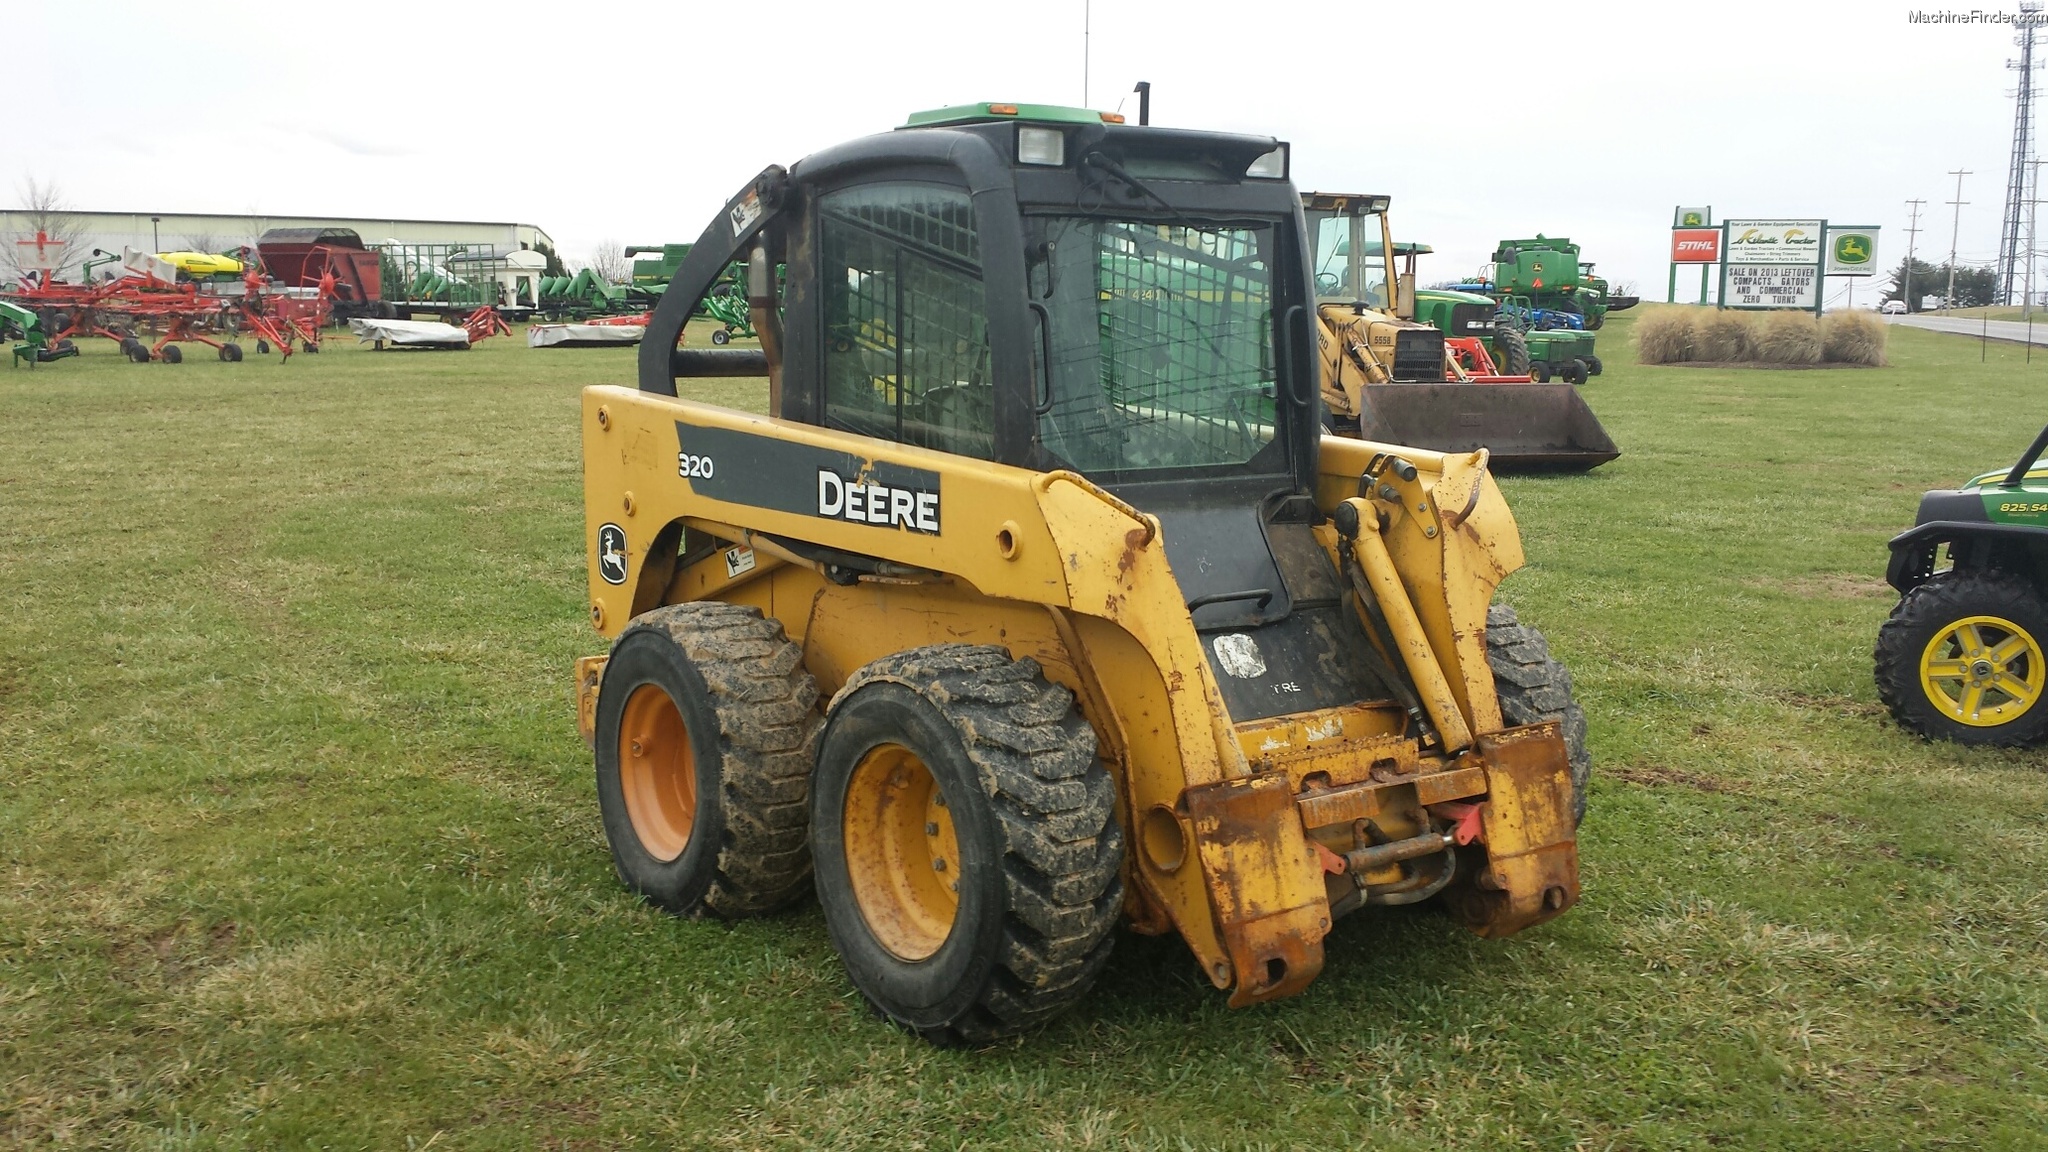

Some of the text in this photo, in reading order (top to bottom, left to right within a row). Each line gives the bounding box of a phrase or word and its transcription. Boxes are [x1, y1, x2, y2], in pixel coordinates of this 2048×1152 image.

[1731, 228, 1816, 244] Atlantic Tractor
[1677, 241, 1715, 250] STIHL
[1729, 268, 1815, 277] SALE ON 2013 LEFTOVER
[1781, 277, 1810, 286] GATORS
[1736, 286, 1804, 295] AND COMMERCIAL
[1743, 295, 1796, 304] ZERO TURNS
[679, 453, 714, 479] 320
[819, 470, 939, 531] DEERE
[2000, 503, 2048, 512] 825i S4
